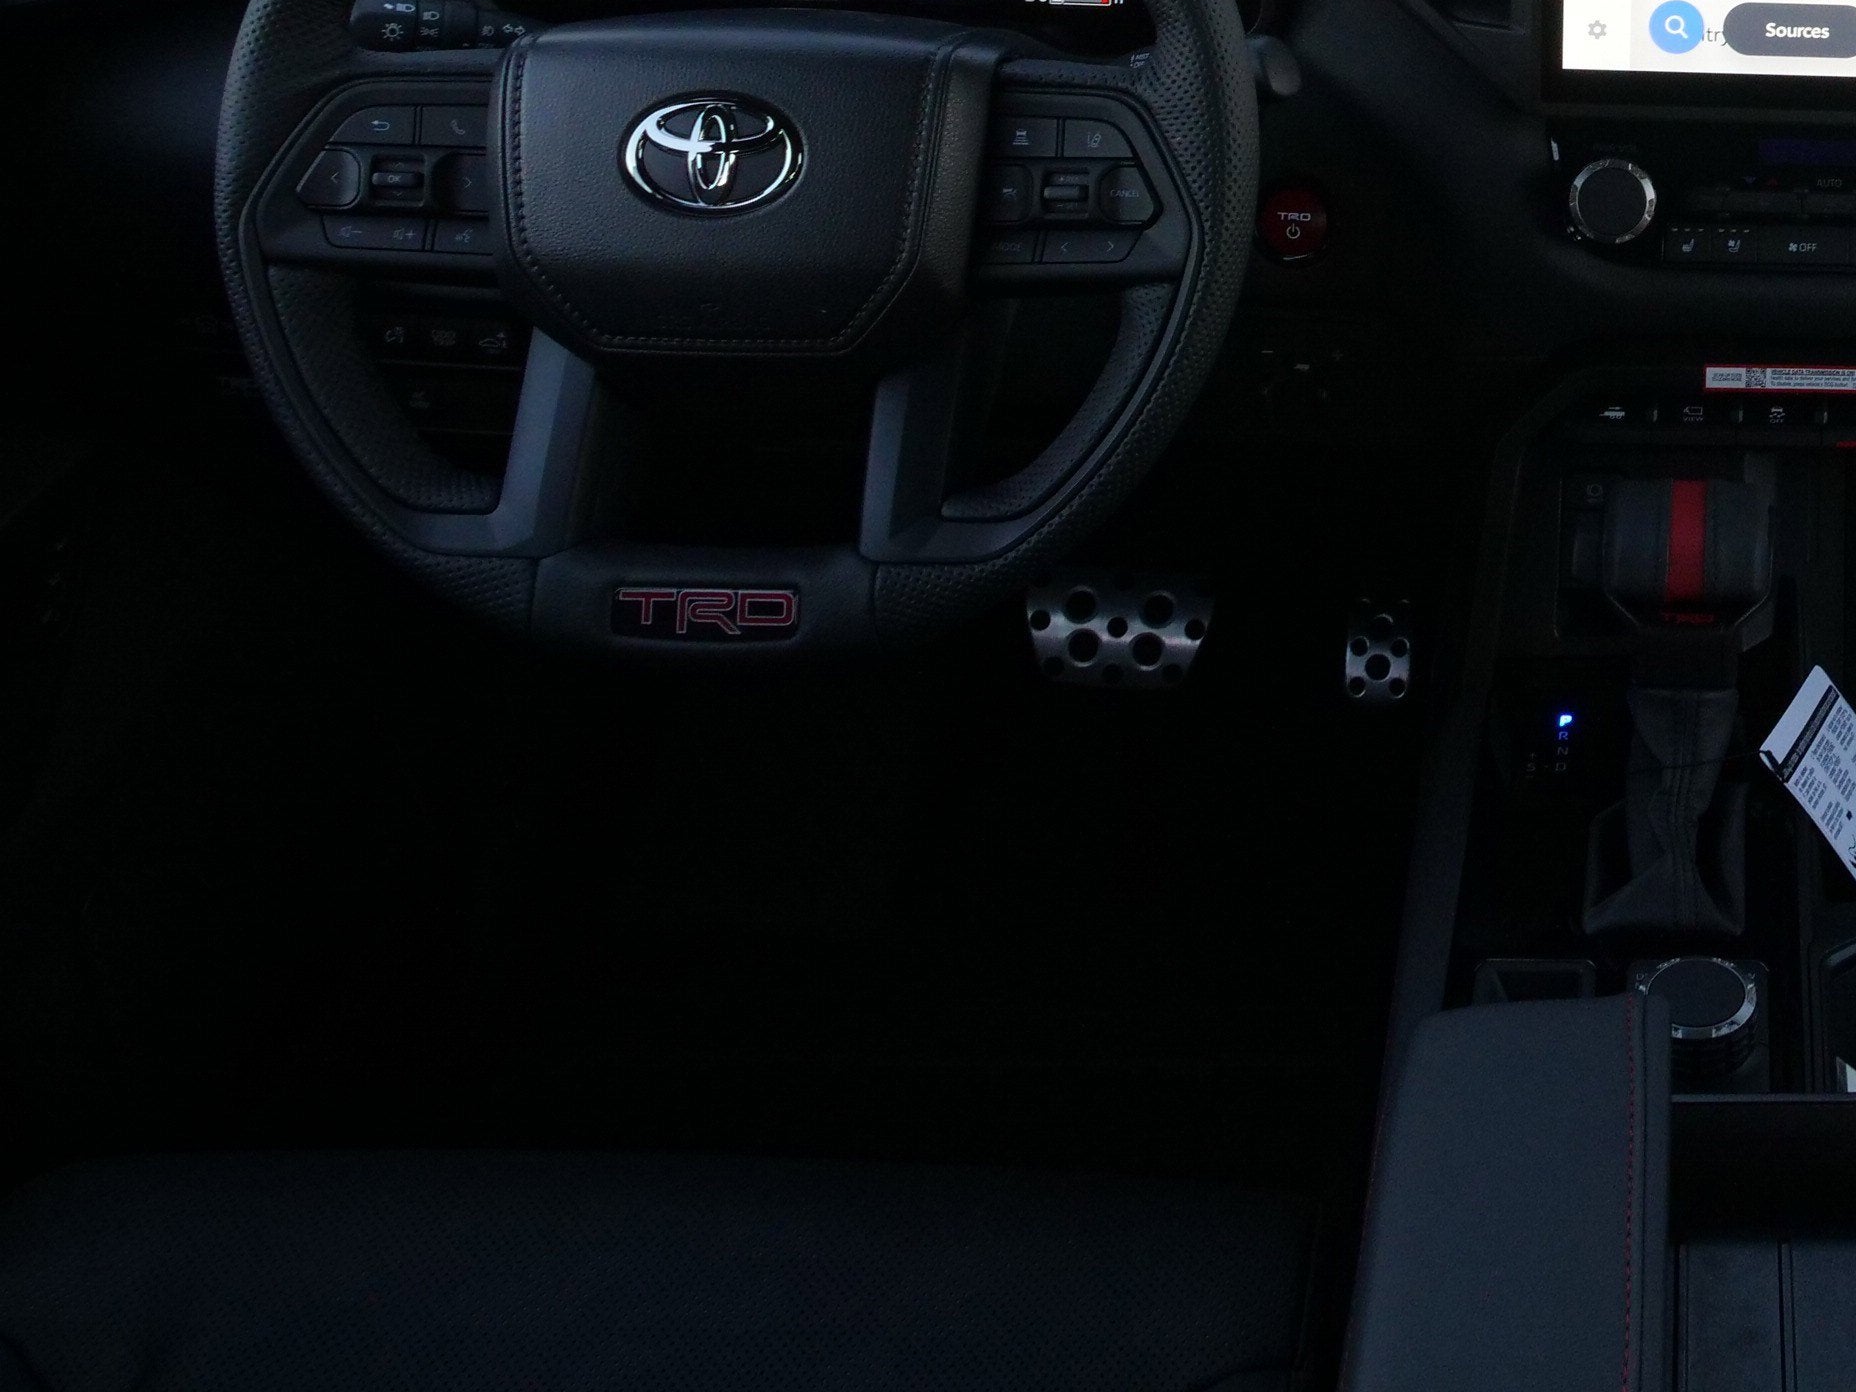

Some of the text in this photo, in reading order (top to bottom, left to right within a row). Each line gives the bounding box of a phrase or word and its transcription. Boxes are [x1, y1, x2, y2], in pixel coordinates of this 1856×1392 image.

[1765, 22, 1830, 39] Sources
[1816, 178, 1843, 189] AUTO
[1110, 189, 1140, 199] CANCEL
[1276, 211, 1312, 221] TRD
[1798, 241, 1818, 253] OFF
[616, 587, 796, 635] TRD
[1559, 714, 1573, 728] P
[1558, 731, 1569, 741] R
